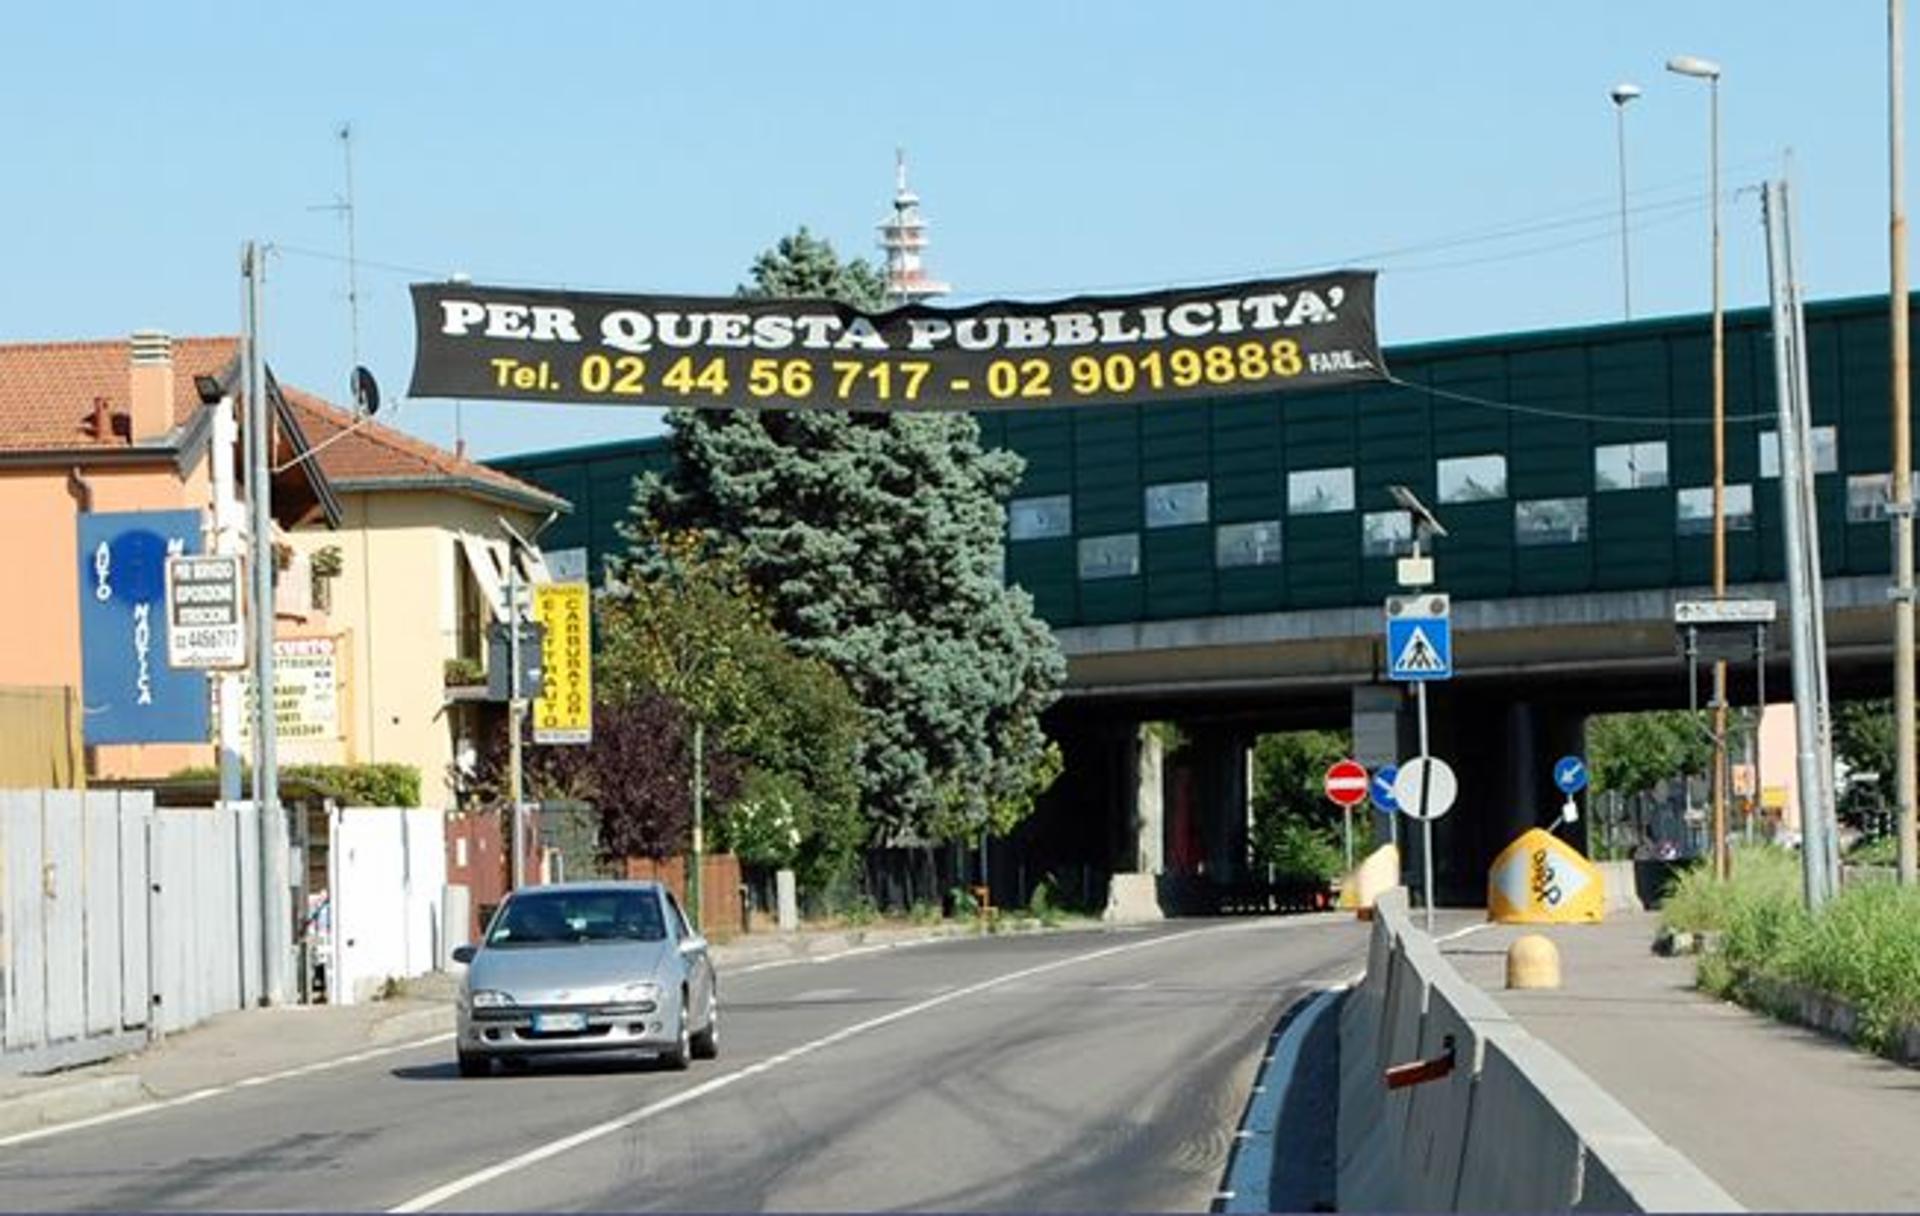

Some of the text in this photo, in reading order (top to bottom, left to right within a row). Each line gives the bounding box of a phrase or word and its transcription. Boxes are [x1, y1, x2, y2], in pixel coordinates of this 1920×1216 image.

[440, 286, 1345, 352] PER QUESTA PUBBLICITA'
[491, 358, 560, 390] Tel.
[579, 354, 645, 394] 02
[661, 356, 728, 394] 44
[748, 359, 813, 396] 56
[832, 361, 932, 400] 717
[986, 360, 1051, 399] 02
[1070, 338, 1303, 396] 9019888
[95, 540, 112, 600] AUTO
[134, 603, 151, 705] NAUTICA
[565, 598, 581, 726] CARBURATORI
